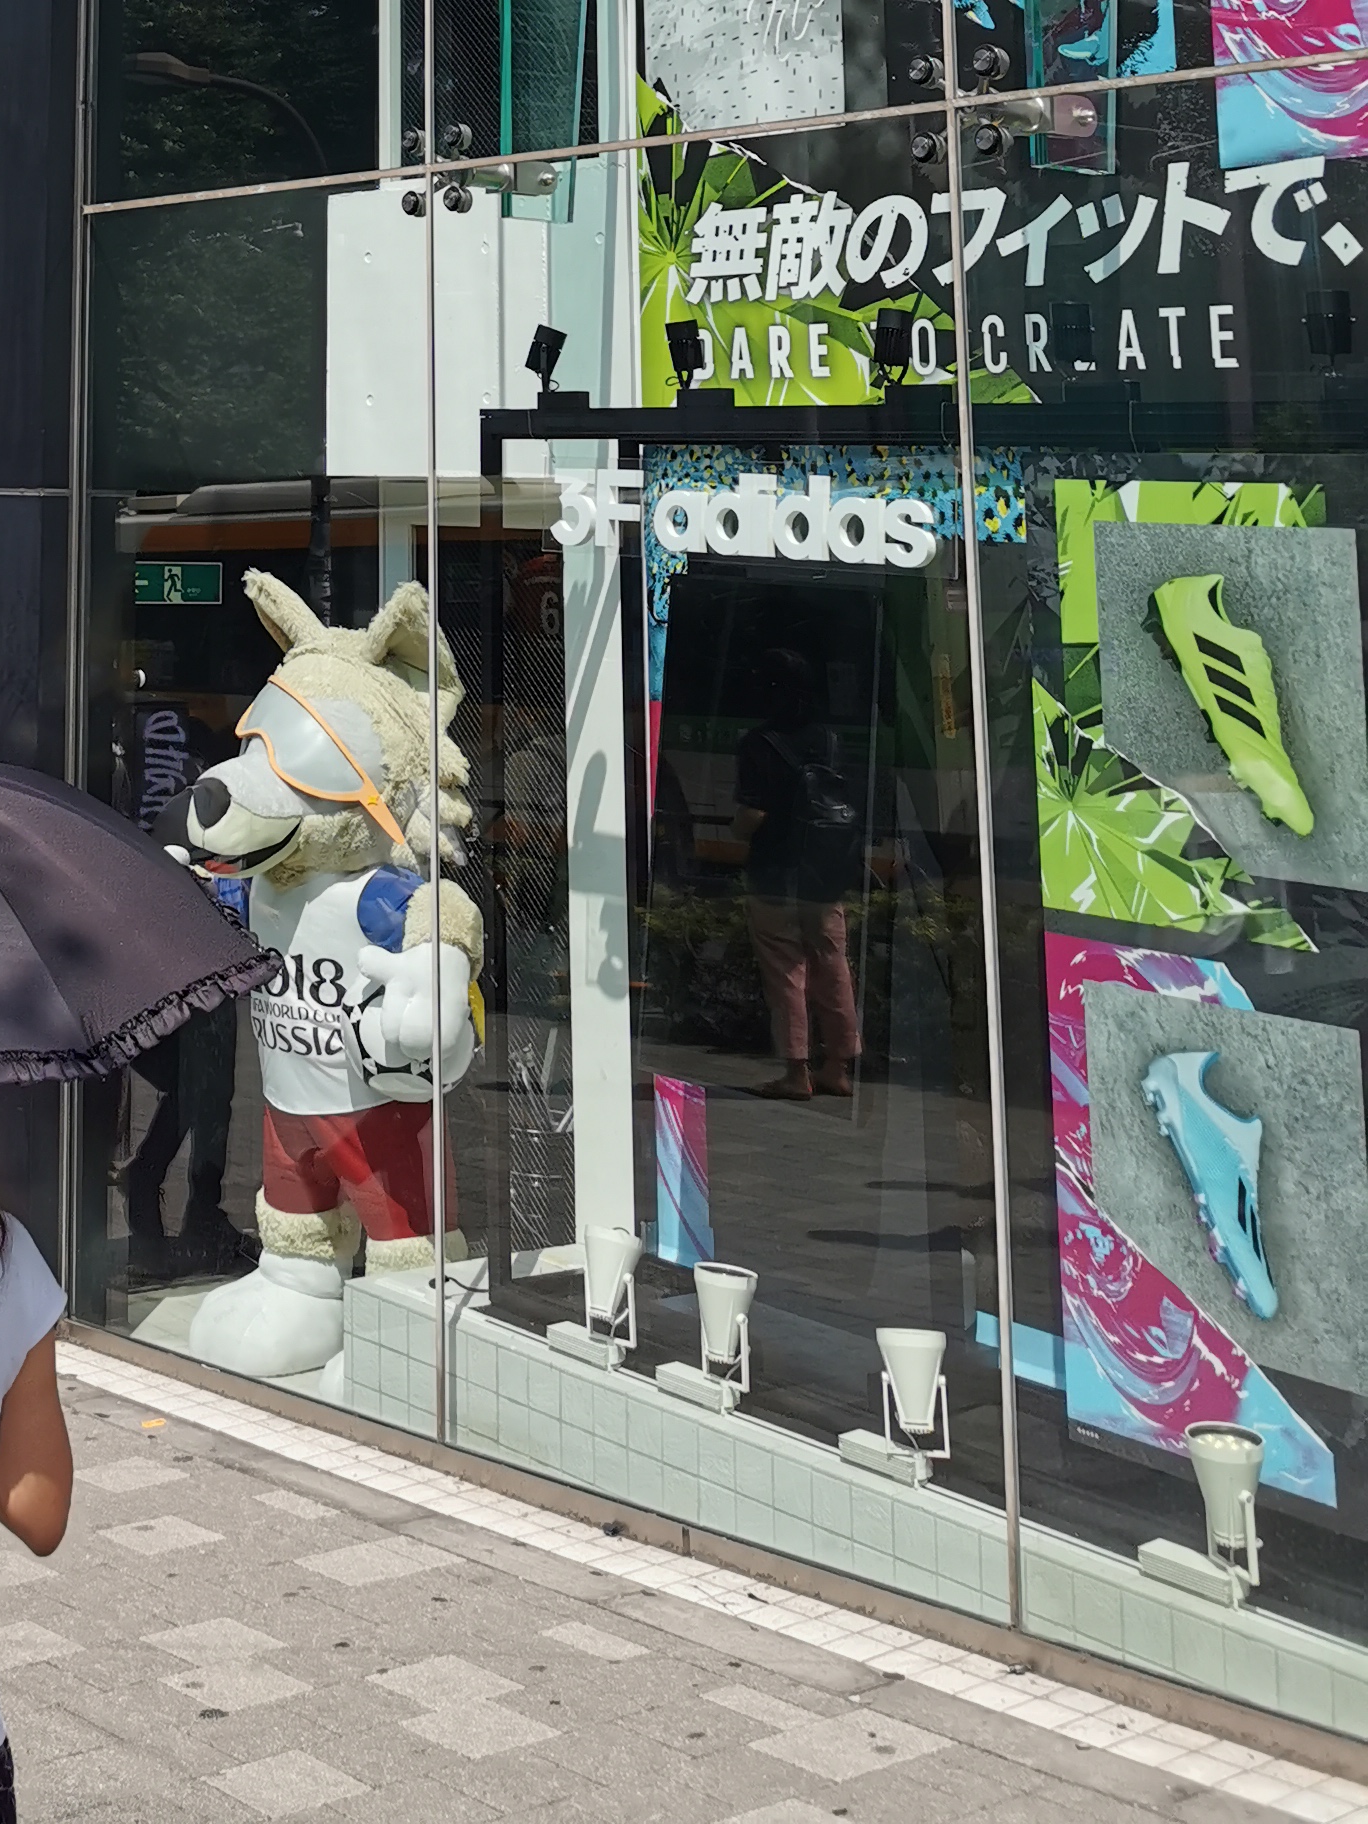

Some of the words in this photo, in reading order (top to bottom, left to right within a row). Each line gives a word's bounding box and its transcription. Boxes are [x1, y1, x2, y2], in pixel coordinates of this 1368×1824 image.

[984, 304, 1239, 372] CRATE
[549, 469, 644, 547] 3F
[653, 472, 935, 569] adidas
[246, 950, 348, 1008] 018
[252, 1016, 345, 1056] RUSSIA
[264, 1002, 309, 1021] WORLD
